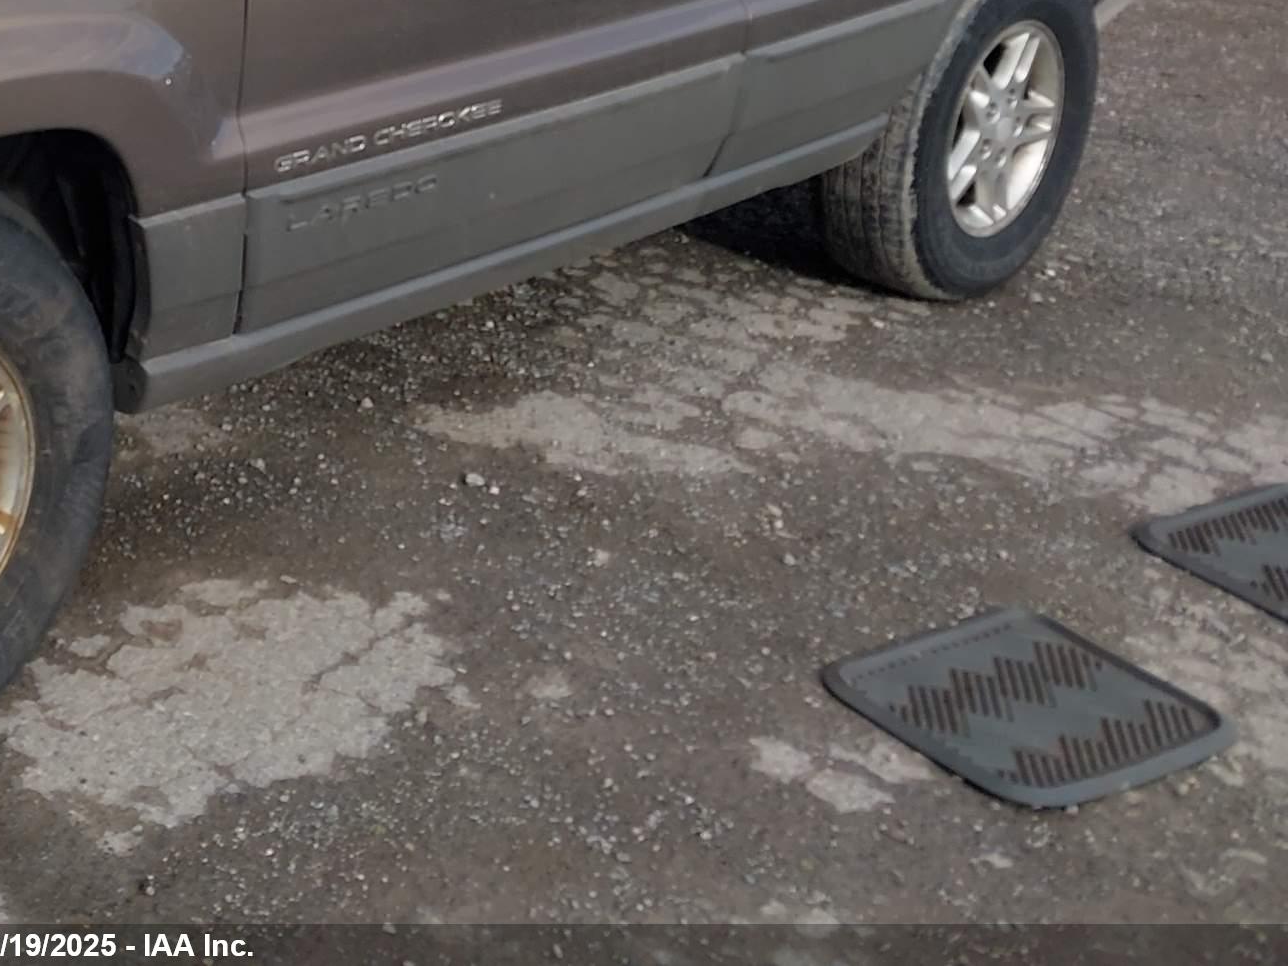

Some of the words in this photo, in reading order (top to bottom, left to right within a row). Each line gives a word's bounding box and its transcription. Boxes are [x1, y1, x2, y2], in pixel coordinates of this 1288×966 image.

[275, 135, 366, 172] GRAND
[373, 99, 503, 146] CHEROKEE
[286, 174, 437, 232] LAREDO
